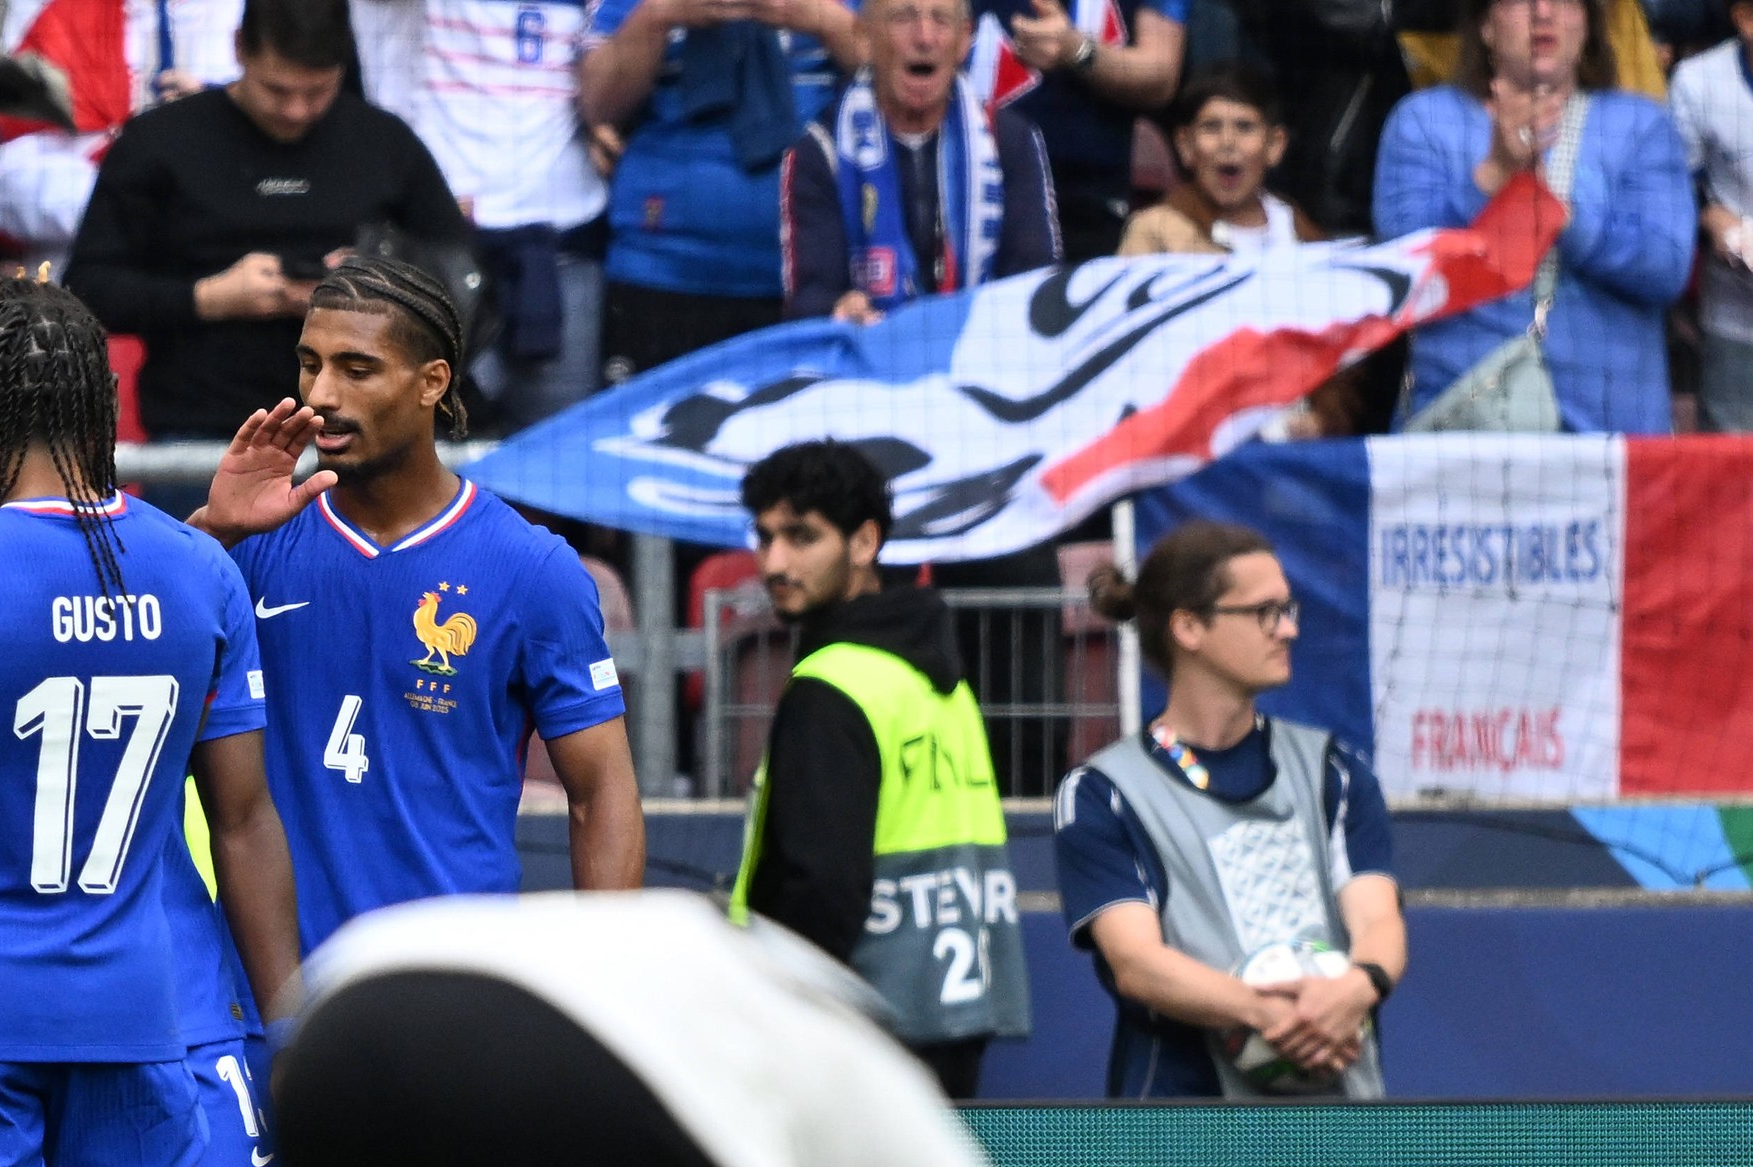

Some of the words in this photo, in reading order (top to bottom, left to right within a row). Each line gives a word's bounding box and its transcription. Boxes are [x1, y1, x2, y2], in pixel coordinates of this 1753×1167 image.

[516, 10, 545, 64] 6
[51, 593, 163, 643] GUSTO
[323, 694, 370, 784] 4
[1411, 707, 1565, 773] FRANÇAIS
[13, 675, 180, 894] 17
